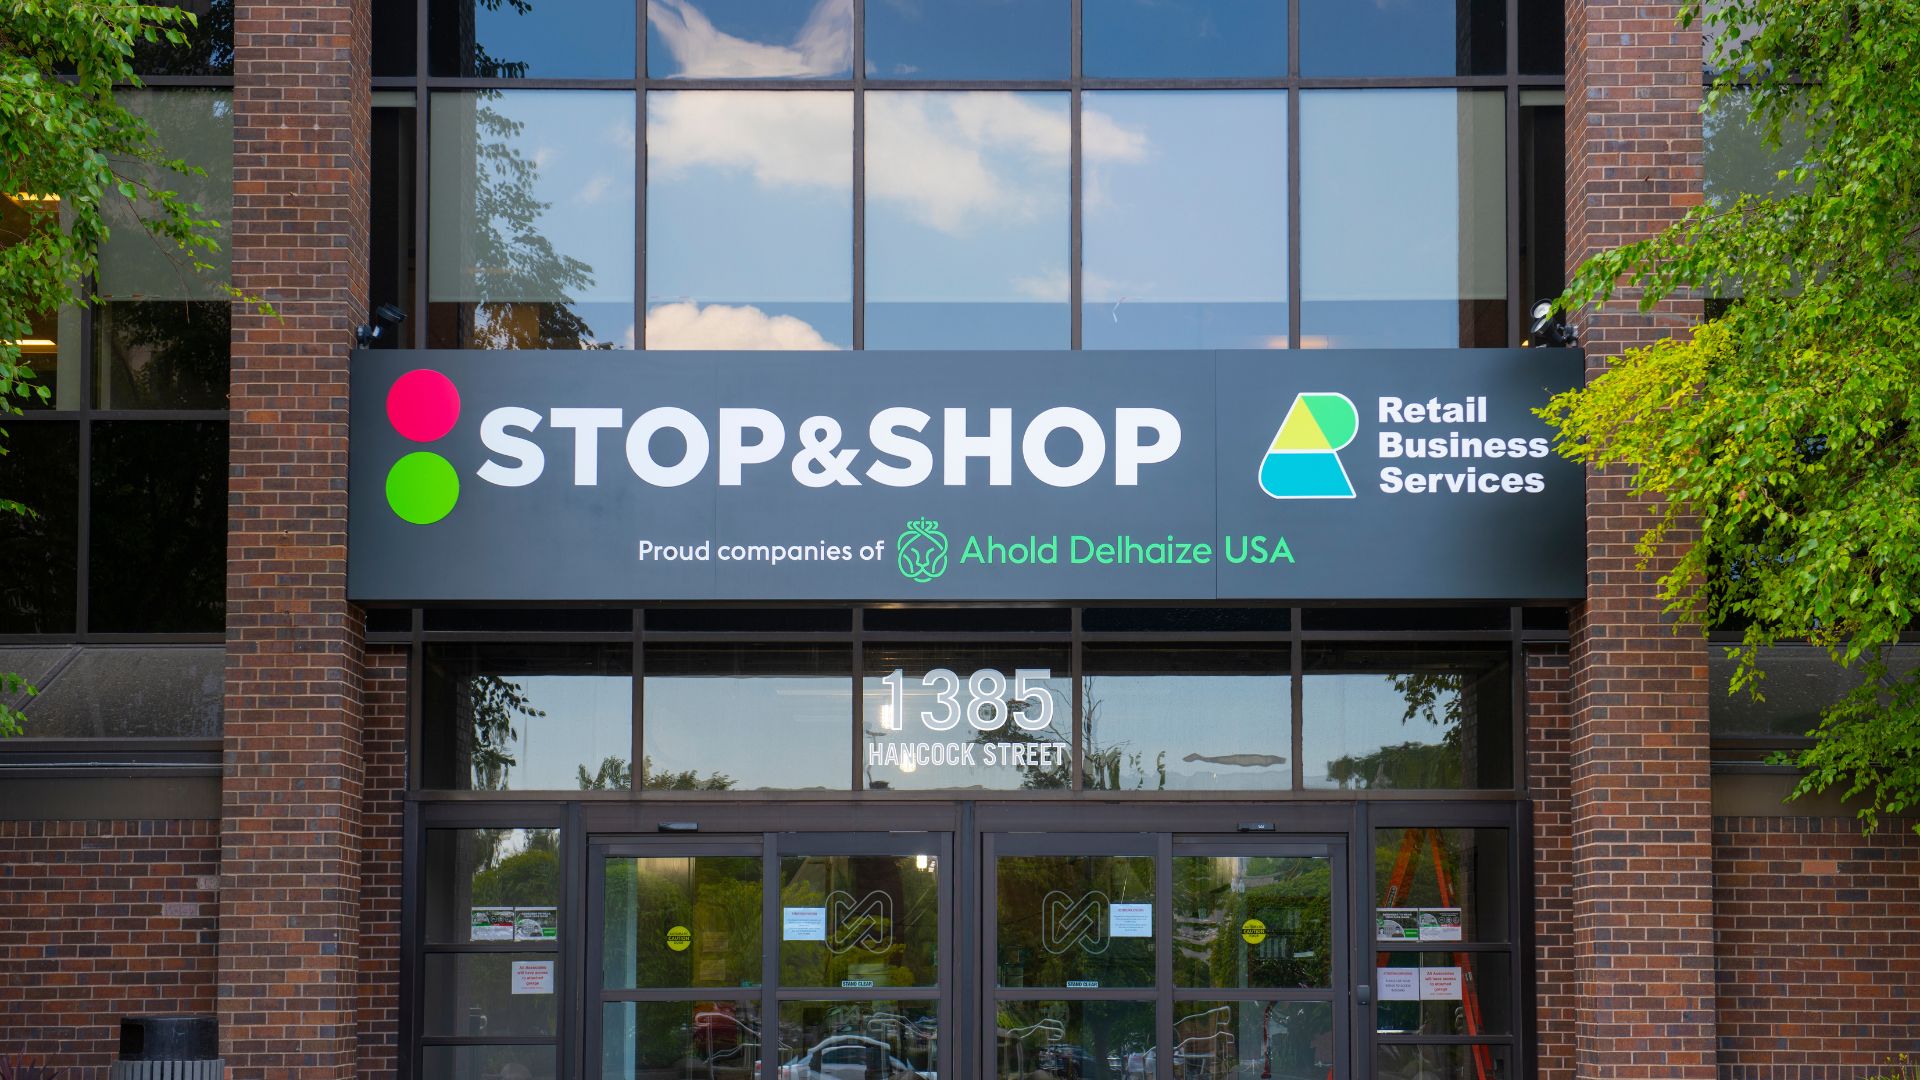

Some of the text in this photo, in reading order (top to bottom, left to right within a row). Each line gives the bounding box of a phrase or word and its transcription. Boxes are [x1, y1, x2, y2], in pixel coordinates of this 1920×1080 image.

[1378, 396, 1487, 423] Retail
[476, 406, 1182, 488] STOP&SHOP
[1378, 431, 1550, 459] Business
[1379, 466, 1546, 494] Services
[639, 535, 1296, 567] Proud companies of Ahold Delhaize USA
[881, 668, 1054, 731] 1385
[868, 742, 1066, 766] HANCOCK STREET
